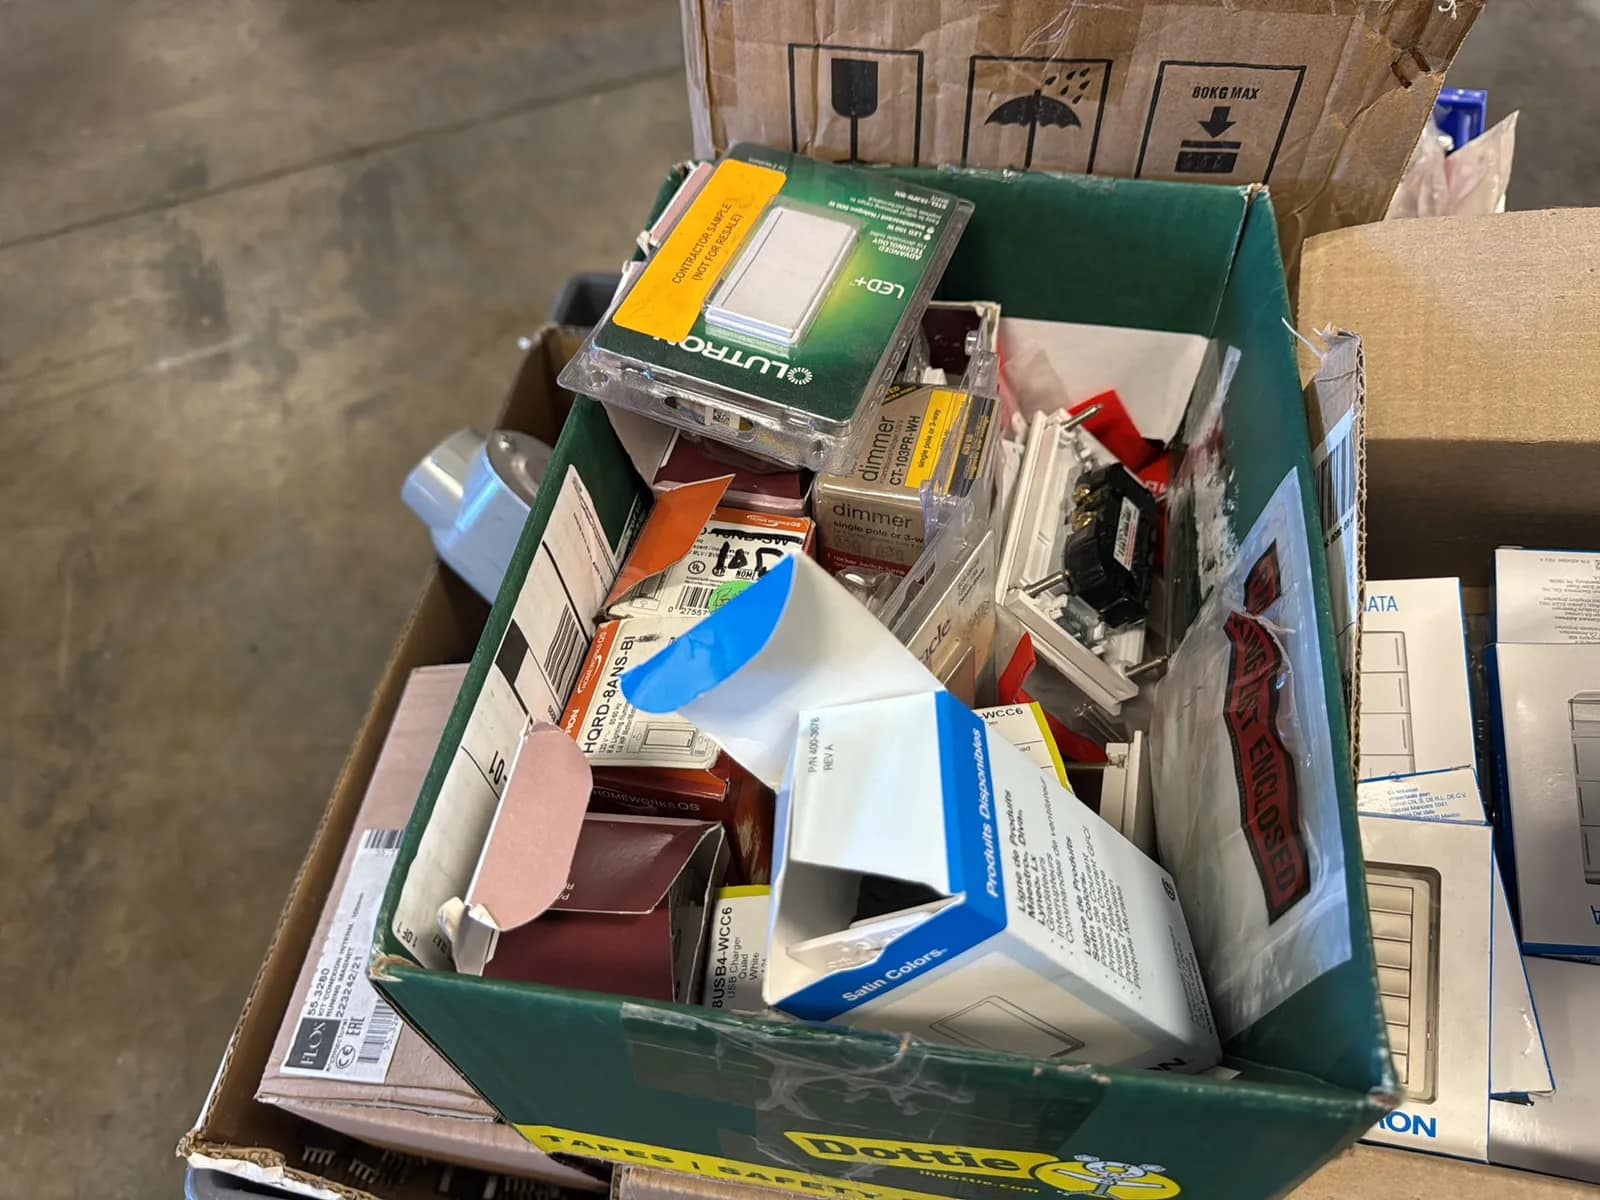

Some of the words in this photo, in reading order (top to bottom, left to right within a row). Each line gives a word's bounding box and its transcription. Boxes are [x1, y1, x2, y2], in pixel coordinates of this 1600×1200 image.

[1191, 86, 1228, 99] 80KG
[1229, 86, 1260, 99] MAX
[672, 232, 710, 284] CONTRACTOR
[706, 202, 733, 232] SAMPLE
[692, 262, 710, 281] (NOT
[704, 245, 721, 262] FOR
[716, 214, 744, 246] RESALE)
[653, 335, 790, 379] LUTRO
[858, 415, 897, 482] dimmer
[890, 415, 921, 486] CT-103PR-WH
[832, 503, 913, 528] dimmer
[833, 521, 863, 533] single
[865, 528, 888, 537] pole
[891, 532, 901, 540] or
[904, 534, 925, 544] 3-w
[583, 636, 637, 753] HQRD-8ANS-BI
[808, 757, 819, 773] P/N
[823, 753, 834, 771] REV
[827, 743, 834, 752] A
[972, 728, 992, 820] Disponibles
[1004, 789, 1018, 847] Produits
[1248, 740, 1298, 892] ENCLOSED
[979, 823, 999, 898] Produits
[1012, 849, 1020, 868] de
[1052, 839, 1060, 856] de
[1066, 835, 1081, 892] Produits
[1015, 870, 1026, 913] Ligne
[1038, 855, 1055, 932] Gradateurs
[1046, 852, 1065, 939] Interrupteurs
[1082, 852, 1097, 902] Courant
[1054, 859, 1075, 944] Commandes
[1076, 894, 1084, 913] de
[730, 937, 742, 974] Charger
[1080, 915, 1092, 956] Ligne
[1088, 925, 1101, 962] Satin
[712, 906, 733, 1009] 8USB4-WCC6
[738, 953, 749, 979] Quad
[750, 952, 761, 980] White
[336, 955, 363, 1018] 223242/21
[727, 976, 738, 999] USB
[842, 978, 888, 1001] Satin
[317, 1001, 327, 1017] KIT
[301, 1021, 327, 1065] FLOS
[540, 1134, 675, 1164] TAPES
[717, 1165, 884, 1200] SAFETY
[806, 1137, 1022, 1171] Dottie
